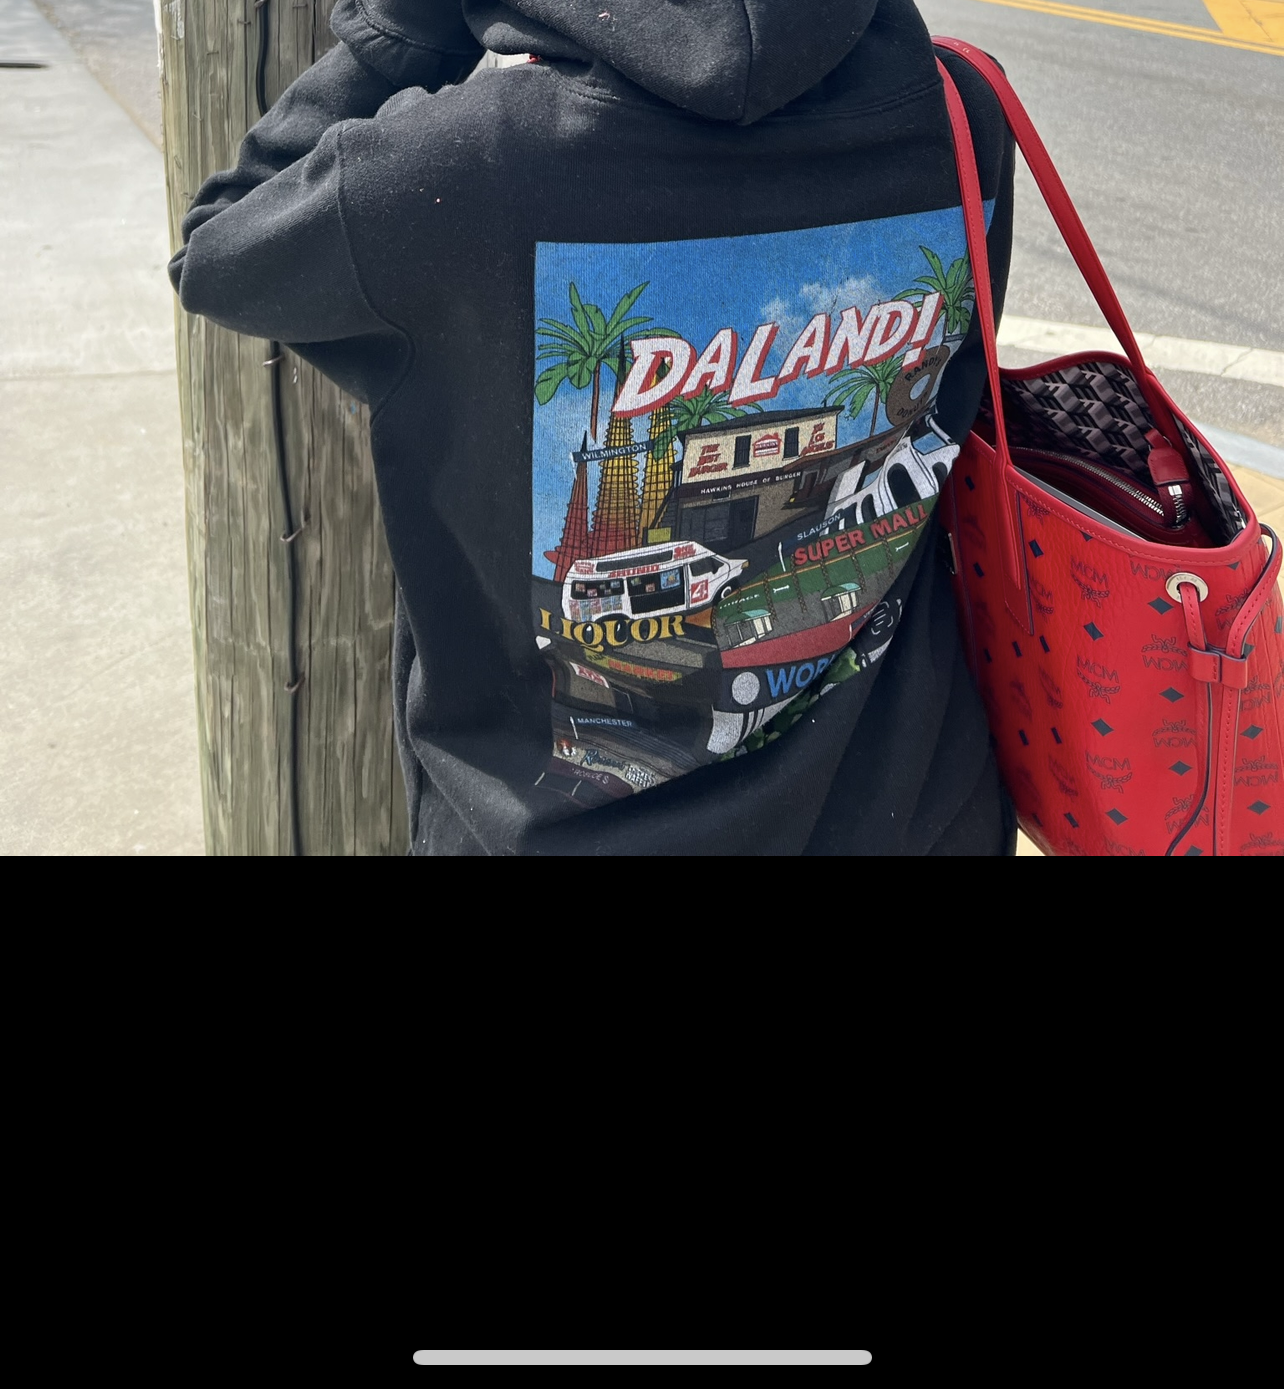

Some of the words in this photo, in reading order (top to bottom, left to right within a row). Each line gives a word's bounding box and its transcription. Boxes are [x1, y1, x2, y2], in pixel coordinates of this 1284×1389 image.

[612, 291, 943, 417] DALAND!
[581, 444, 647, 461] WILMINGTON
[700, 484, 732, 494] HAWKINS
[736, 479, 758, 488] HOUSE
[762, 476, 771, 484] OF
[794, 528, 866, 566] SUPER
[870, 503, 929, 538] MALL
[796, 512, 841, 541] SLAUSON
[1071, 556, 1110, 586] MCM
[539, 608, 687, 653] LIQUOR
[765, 653, 836, 699] WOR
[1077, 655, 1119, 683] MCM
[577, 717, 634, 728] MANCHESTER
[1086, 750, 1132, 771] MCM
